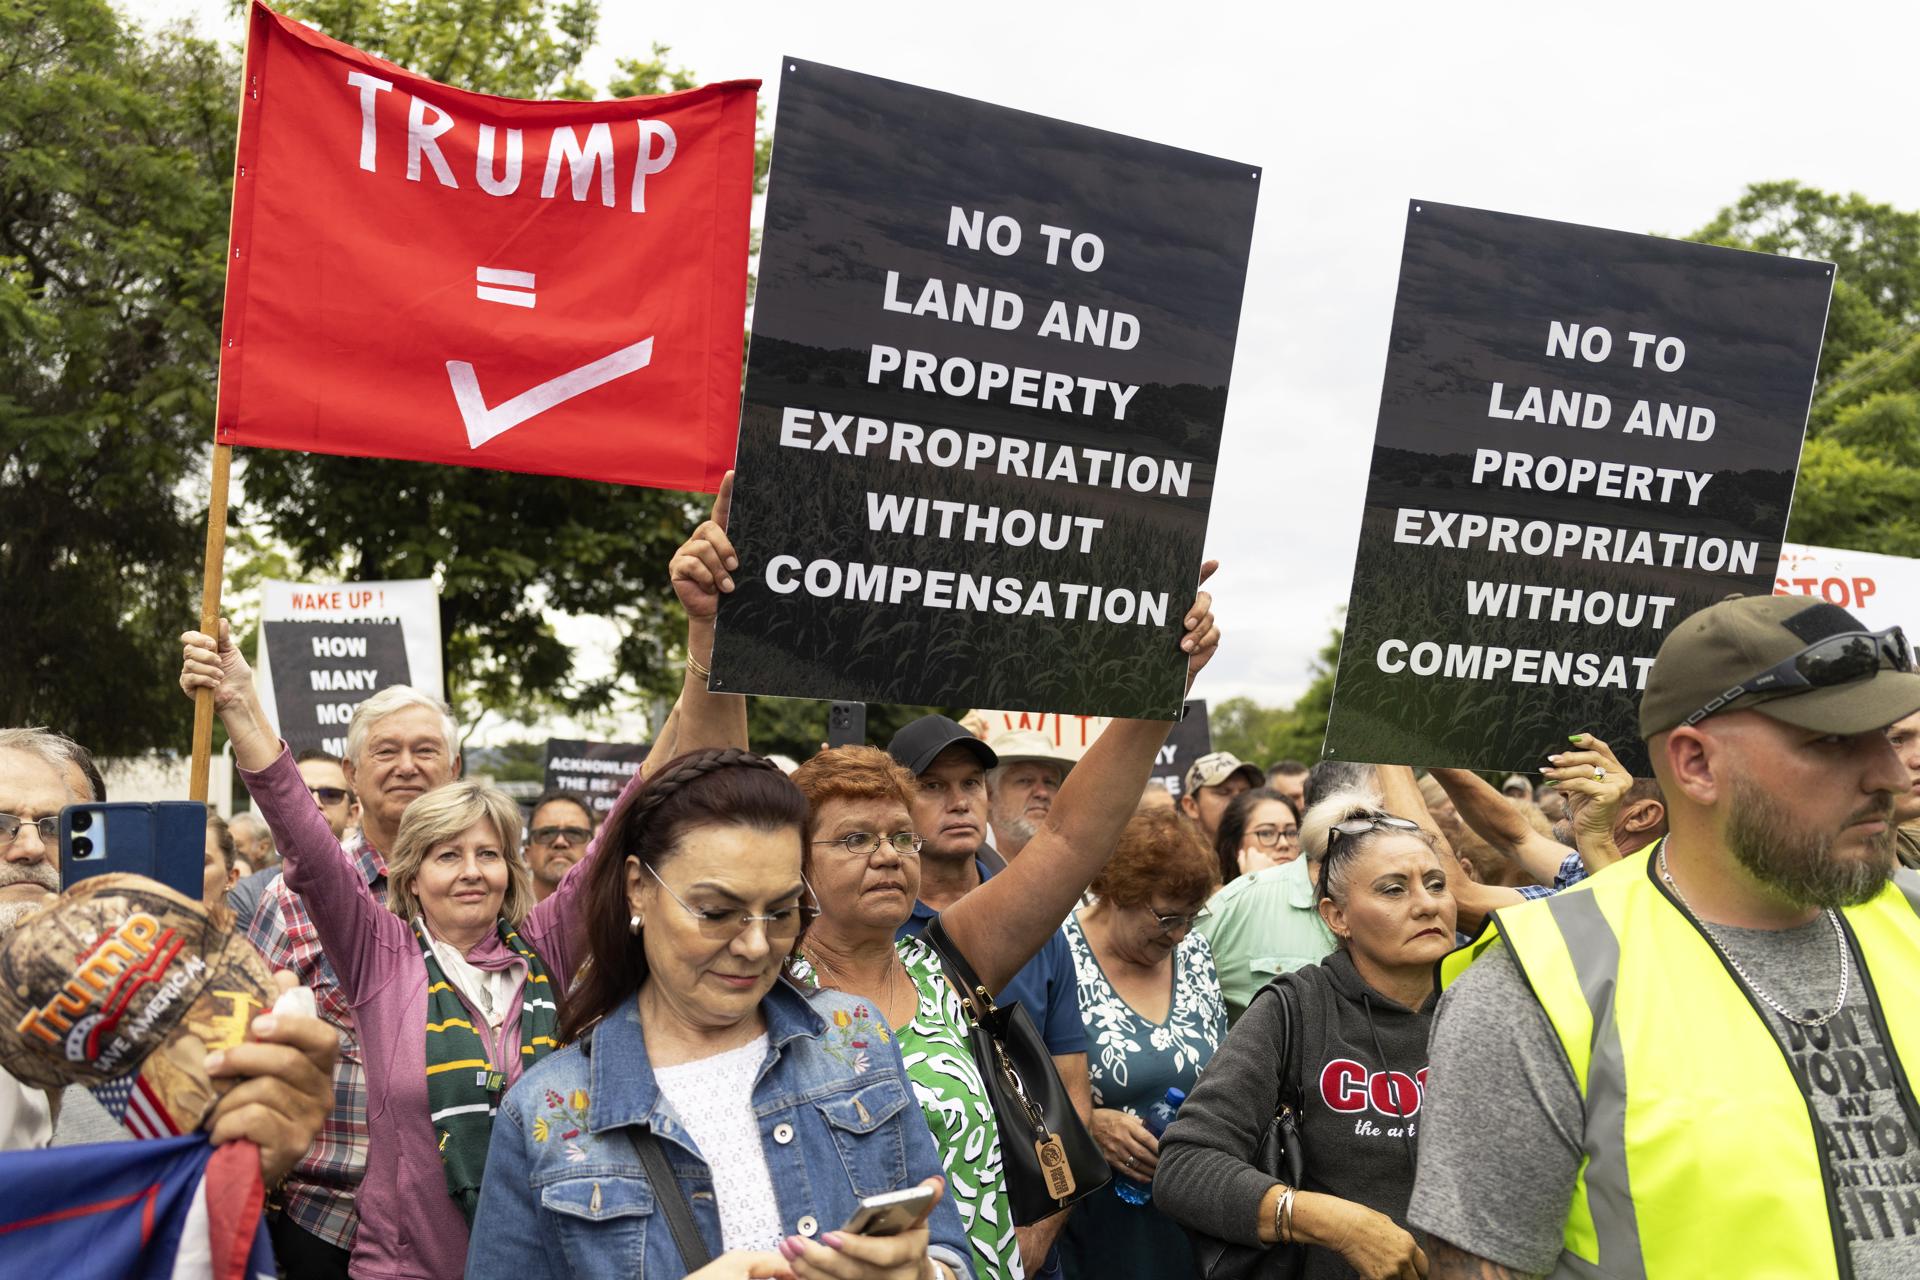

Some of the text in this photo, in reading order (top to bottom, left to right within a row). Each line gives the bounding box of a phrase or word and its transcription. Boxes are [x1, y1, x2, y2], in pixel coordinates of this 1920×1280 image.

[348, 71, 677, 213] TRUMP
[947, 206, 1104, 272] NO TO
[884, 271, 1141, 351] LAND AND
[1546, 321, 1685, 373] NO TO
[868, 344, 1140, 420] PROPERTY
[1488, 382, 1716, 442] LAND AND
[780, 406, 1192, 497] EXPROPRIATION
[1472, 448, 1713, 506] PROPERTY
[867, 492, 1104, 554] WITHOUT
[1394, 507, 1759, 575] EXPROPRIATION
[292, 591, 341, 609] WAKE
[349, 591, 373, 608] UP
[766, 555, 1169, 627] COMPENSATION
[1467, 581, 1675, 629] WITHOUT
[312, 637, 367, 657] HOW
[310, 669, 378, 691] MANY
[316, 703, 360, 725] MO
[557, 776, 587, 791] THE
[1355, 1119, 1382, 1137] the
[1837, 1096, 1871, 1116] MY
